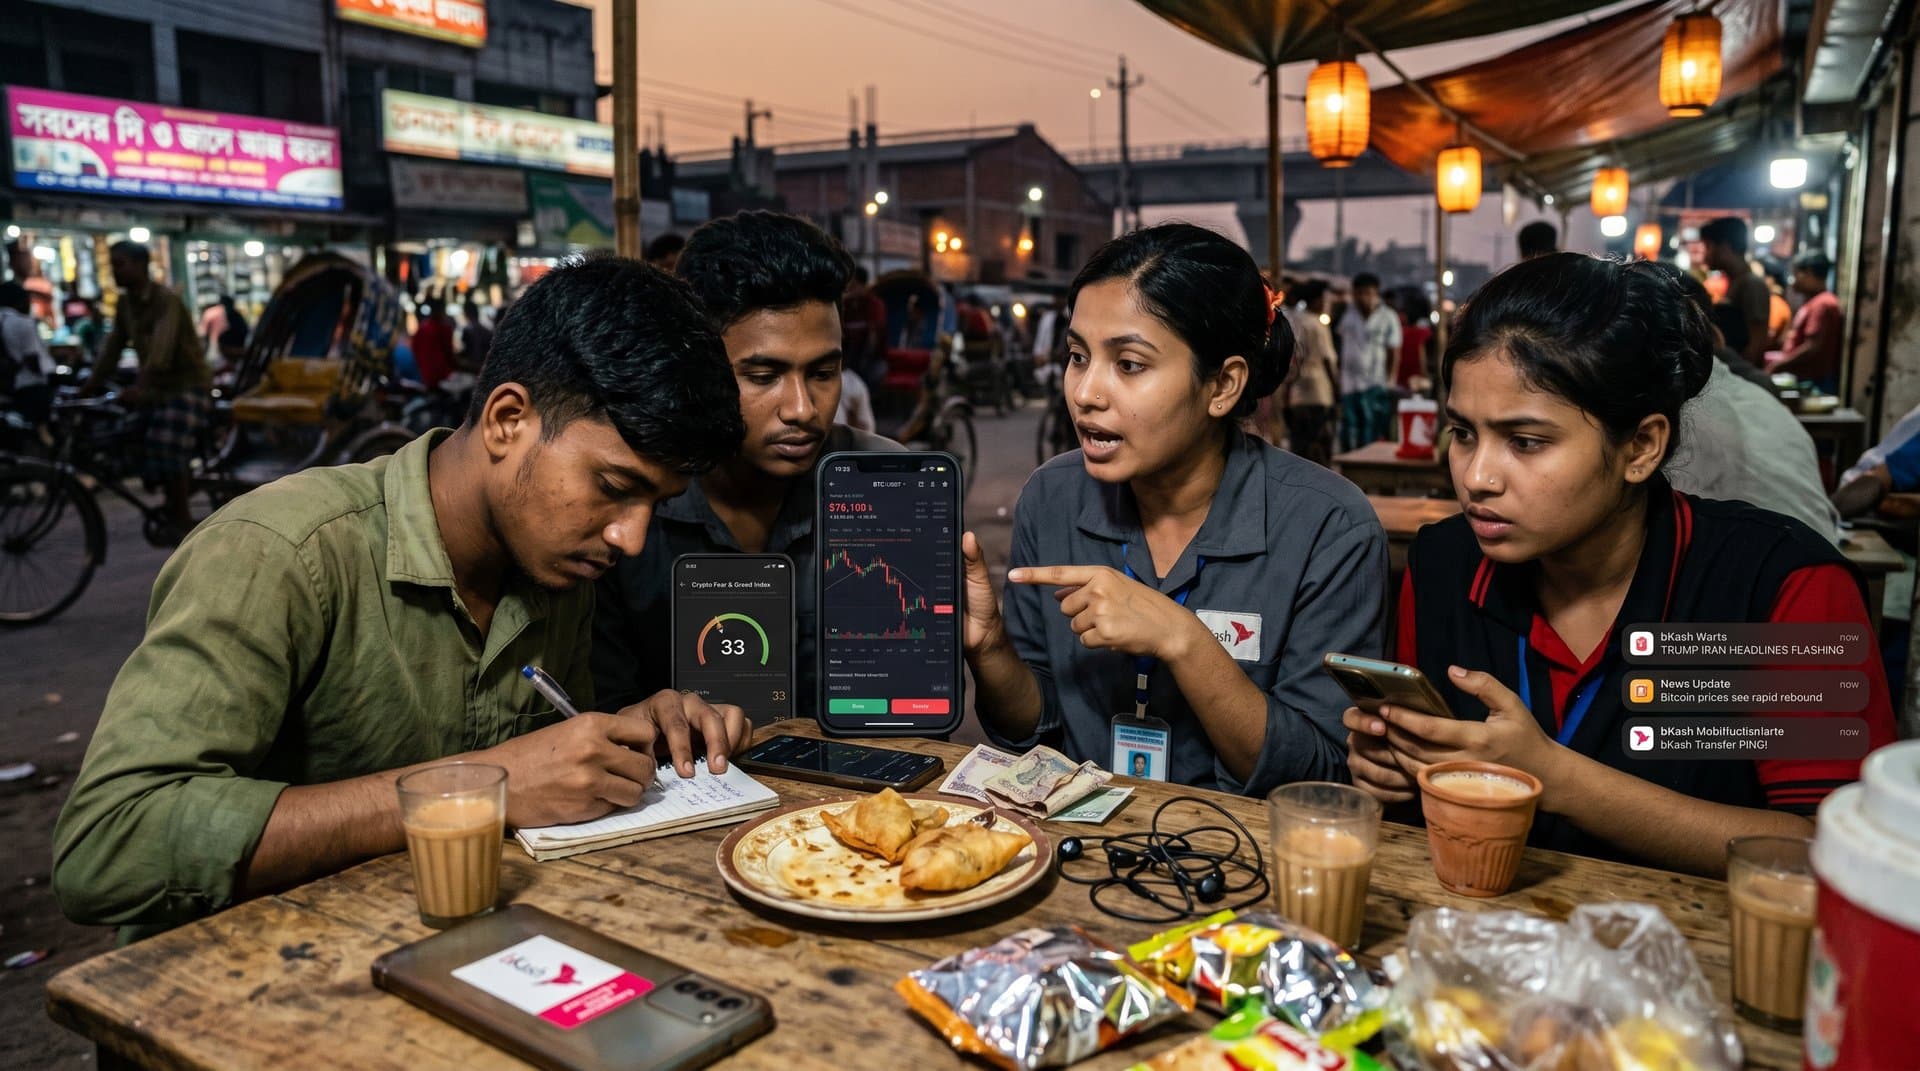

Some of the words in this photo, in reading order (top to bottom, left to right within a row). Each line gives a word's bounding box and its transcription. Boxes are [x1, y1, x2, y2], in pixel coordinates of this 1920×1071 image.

[829, 503, 867, 513] $76,100
[691, 581, 713, 590] Crypto
[713, 581, 727, 589] Fear
[728, 581, 733, 589] &
[734, 581, 753, 589] Greed
[754, 581, 771, 589] Index
[721, 639, 745, 655] 33
[772, 690, 786, 701] 33
